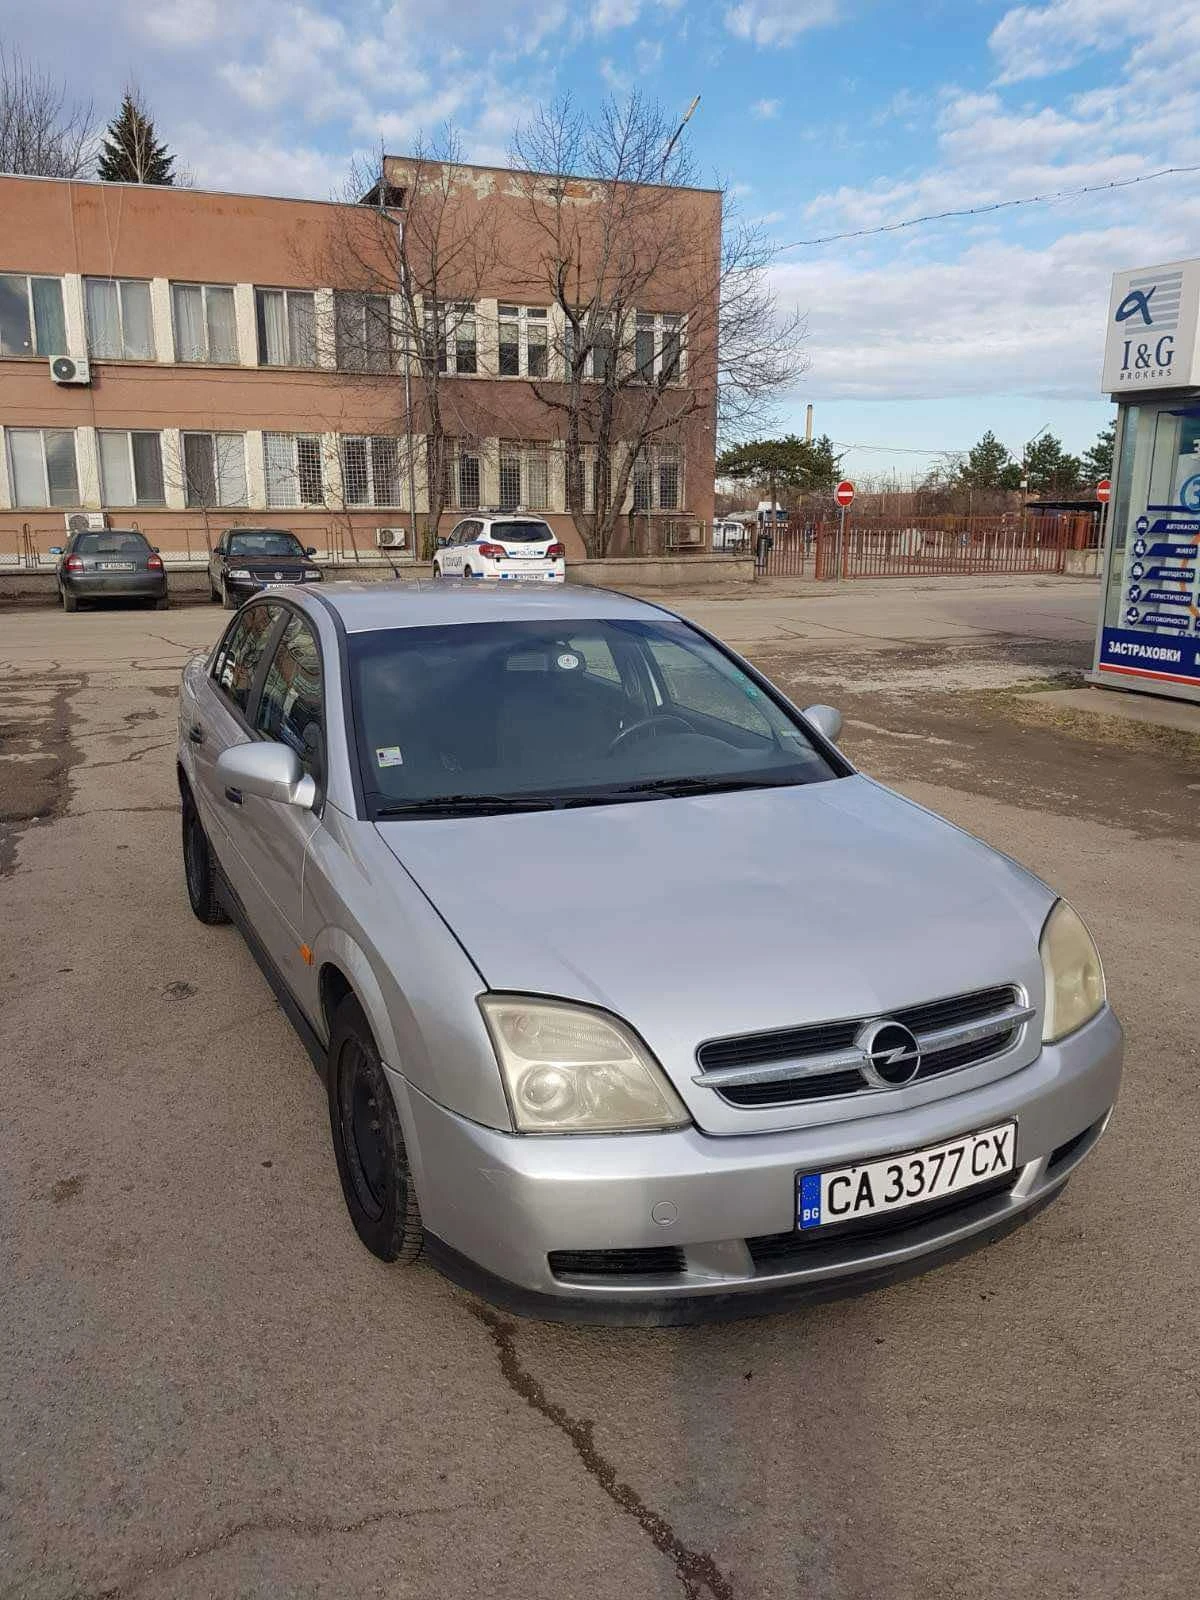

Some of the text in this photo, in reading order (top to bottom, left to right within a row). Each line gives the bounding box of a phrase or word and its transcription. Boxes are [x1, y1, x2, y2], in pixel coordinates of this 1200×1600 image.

[1121, 336, 1175, 371] I&G
[1119, 369, 1173, 381] BROKERS
[1108, 641, 1181, 663] ЗАСТРАХОВКИ
[827, 1131, 1009, 1215] CA 3377 CX
[802, 1207, 819, 1220] BG
